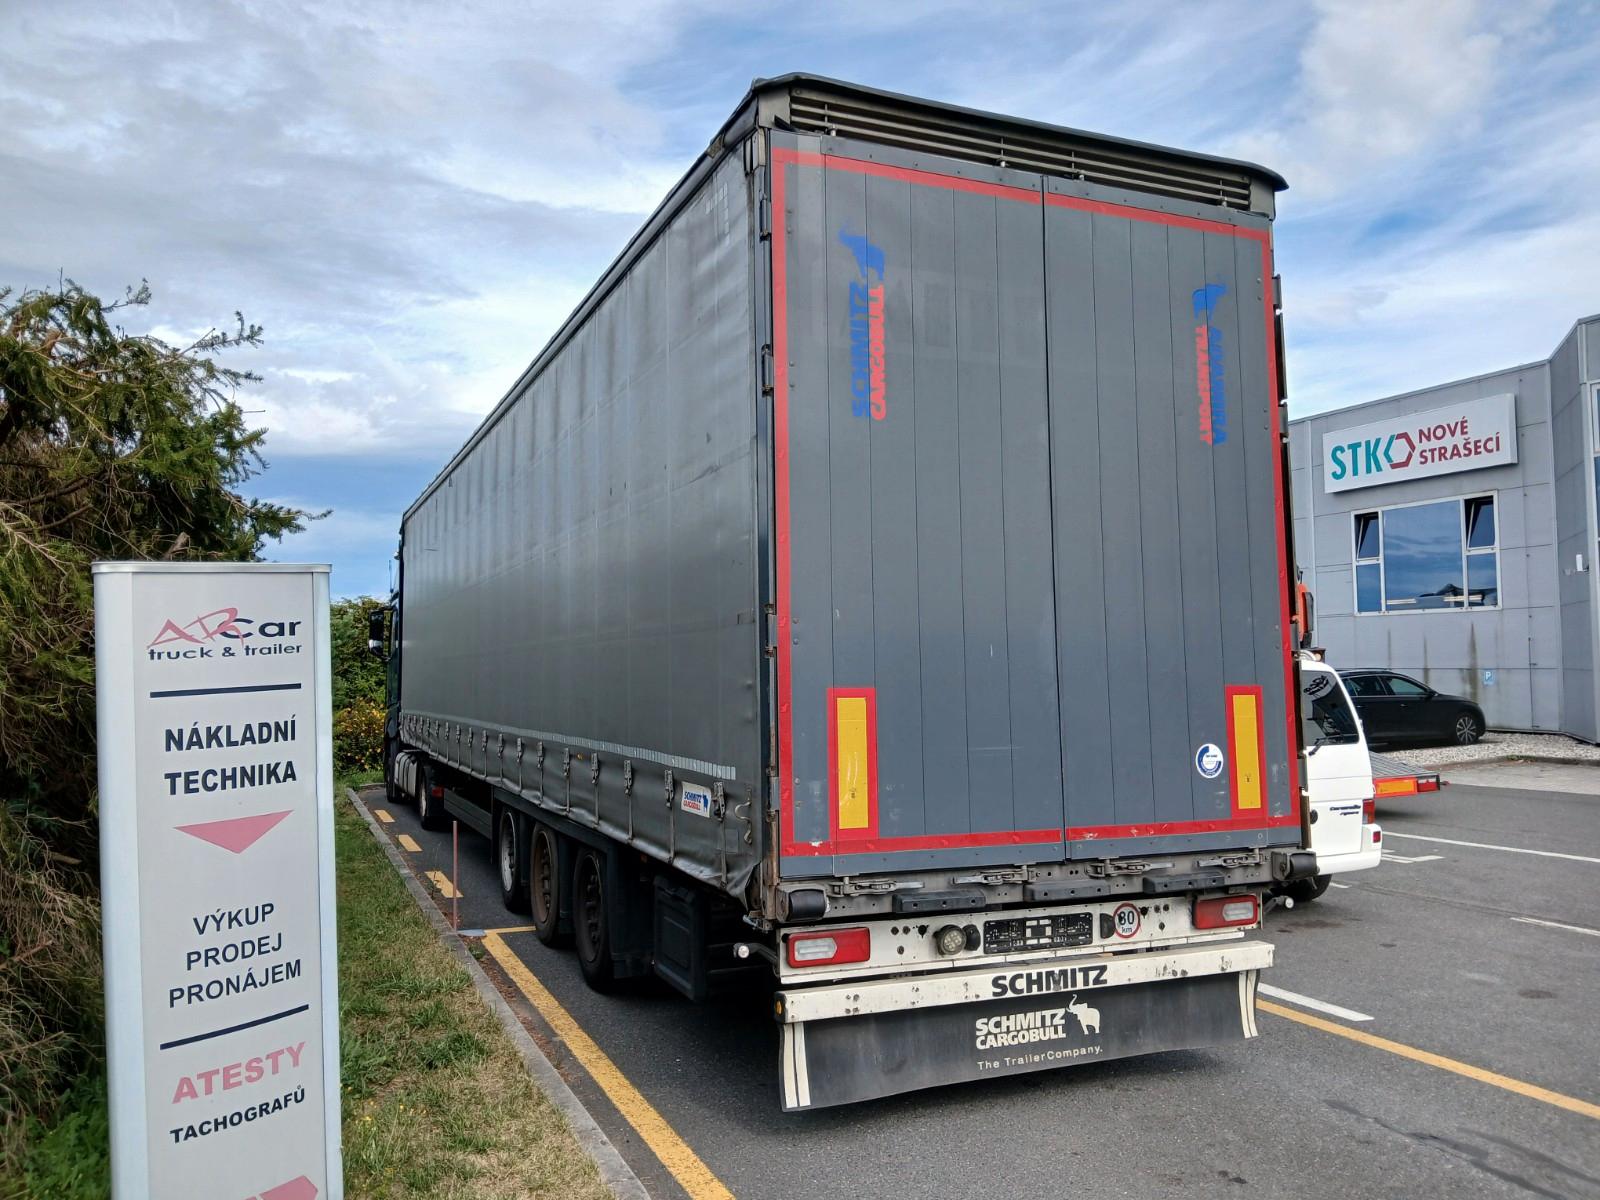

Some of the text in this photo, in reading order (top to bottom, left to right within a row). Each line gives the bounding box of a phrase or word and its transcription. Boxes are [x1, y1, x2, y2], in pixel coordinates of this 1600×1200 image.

[869, 284, 886, 420] CARGOBULL
[1418, 416, 1468, 444] NOVÉ
[1419, 432, 1501, 465] STRAŠECÍ
[148, 643, 302, 660] truck & trailer
[165, 713, 296, 752] NÁKLADNÍ
[164, 761, 297, 795] TECHNIKA
[193, 902, 274, 935] VÝKUP
[1118, 911, 1135, 926] 80
[186, 933, 282, 970] PRODEJ
[169, 959, 302, 1008] PRONÁJEM
[992, 964, 1108, 997] SCHMITZ
[975, 1008, 1066, 1036] SCHMITZ
[976, 1025, 1066, 1050] CARGOBULL
[172, 1041, 306, 1104] ATESTY
[977, 1060, 1000, 1071] The
[169, 1084, 306, 1144] TACHOGRAFŮ
